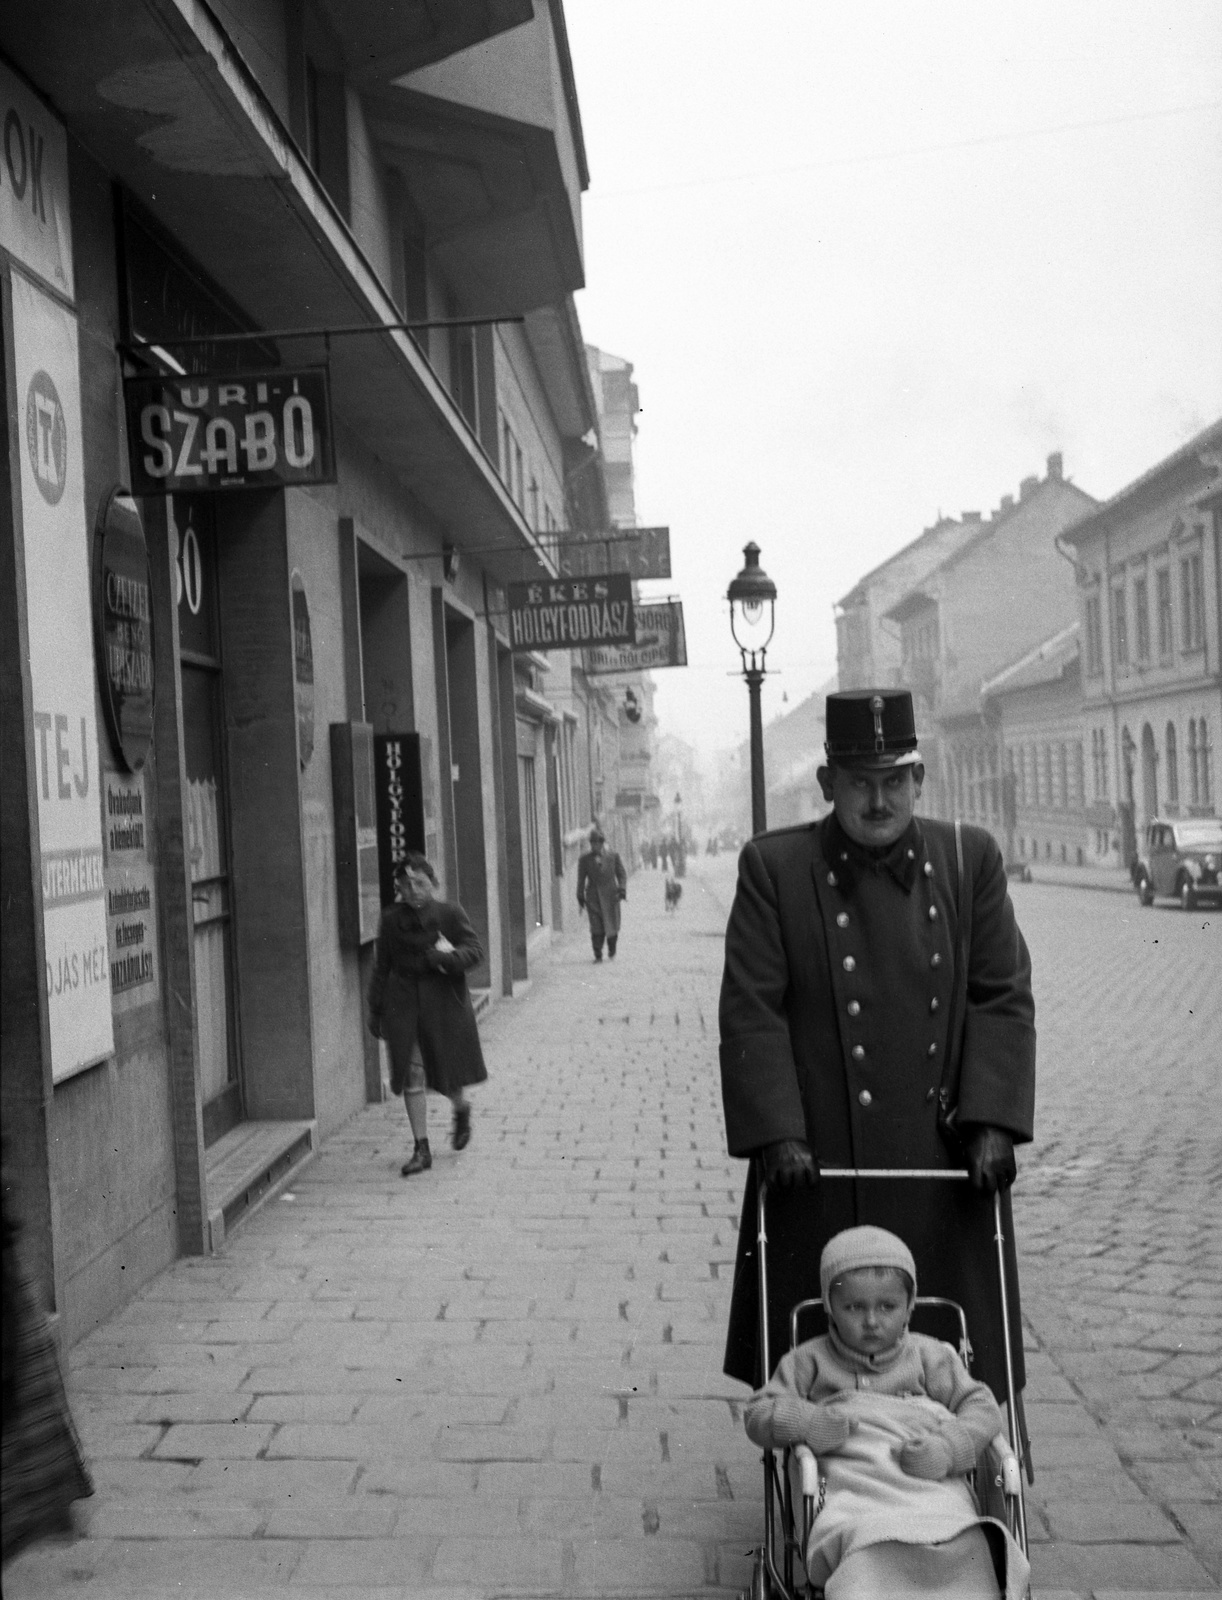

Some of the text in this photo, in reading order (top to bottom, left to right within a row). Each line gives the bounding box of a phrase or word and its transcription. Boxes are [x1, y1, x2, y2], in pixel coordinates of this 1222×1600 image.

[3, 107, 46, 225] OK
[141, 377, 314, 478] SZABÓ
[35, 711, 89, 800] TEJ
[83, 936, 107, 990] MÉZ
